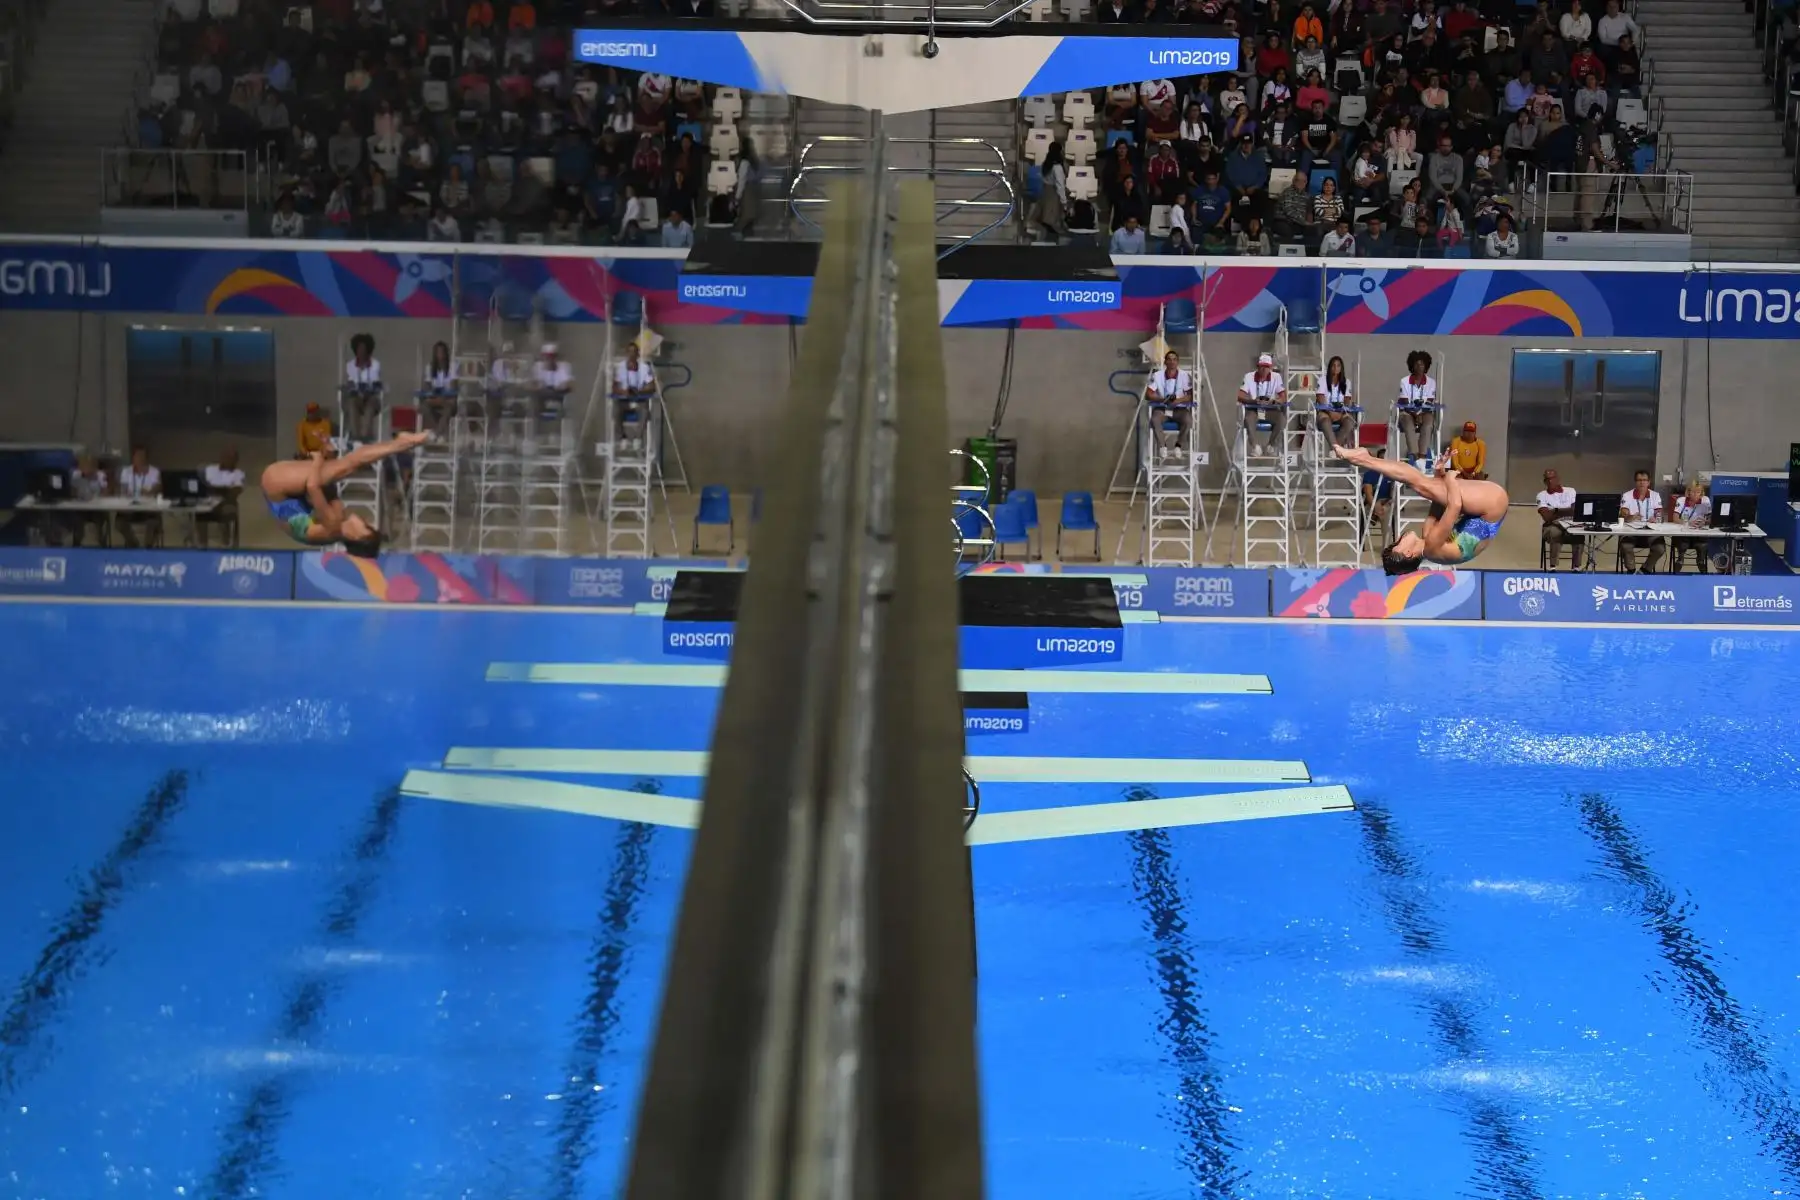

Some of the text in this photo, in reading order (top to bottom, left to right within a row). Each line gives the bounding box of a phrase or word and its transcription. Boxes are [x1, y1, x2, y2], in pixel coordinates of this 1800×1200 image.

[1174, 577, 1233, 592] PANAM
[1503, 577, 1560, 597] GLORIA
[1174, 592, 1235, 607] SPORTS
[1612, 589, 1676, 601] LATAM
[1713, 585, 1793, 608] Petramás
[1612, 604, 1676, 613] AIRLINES
